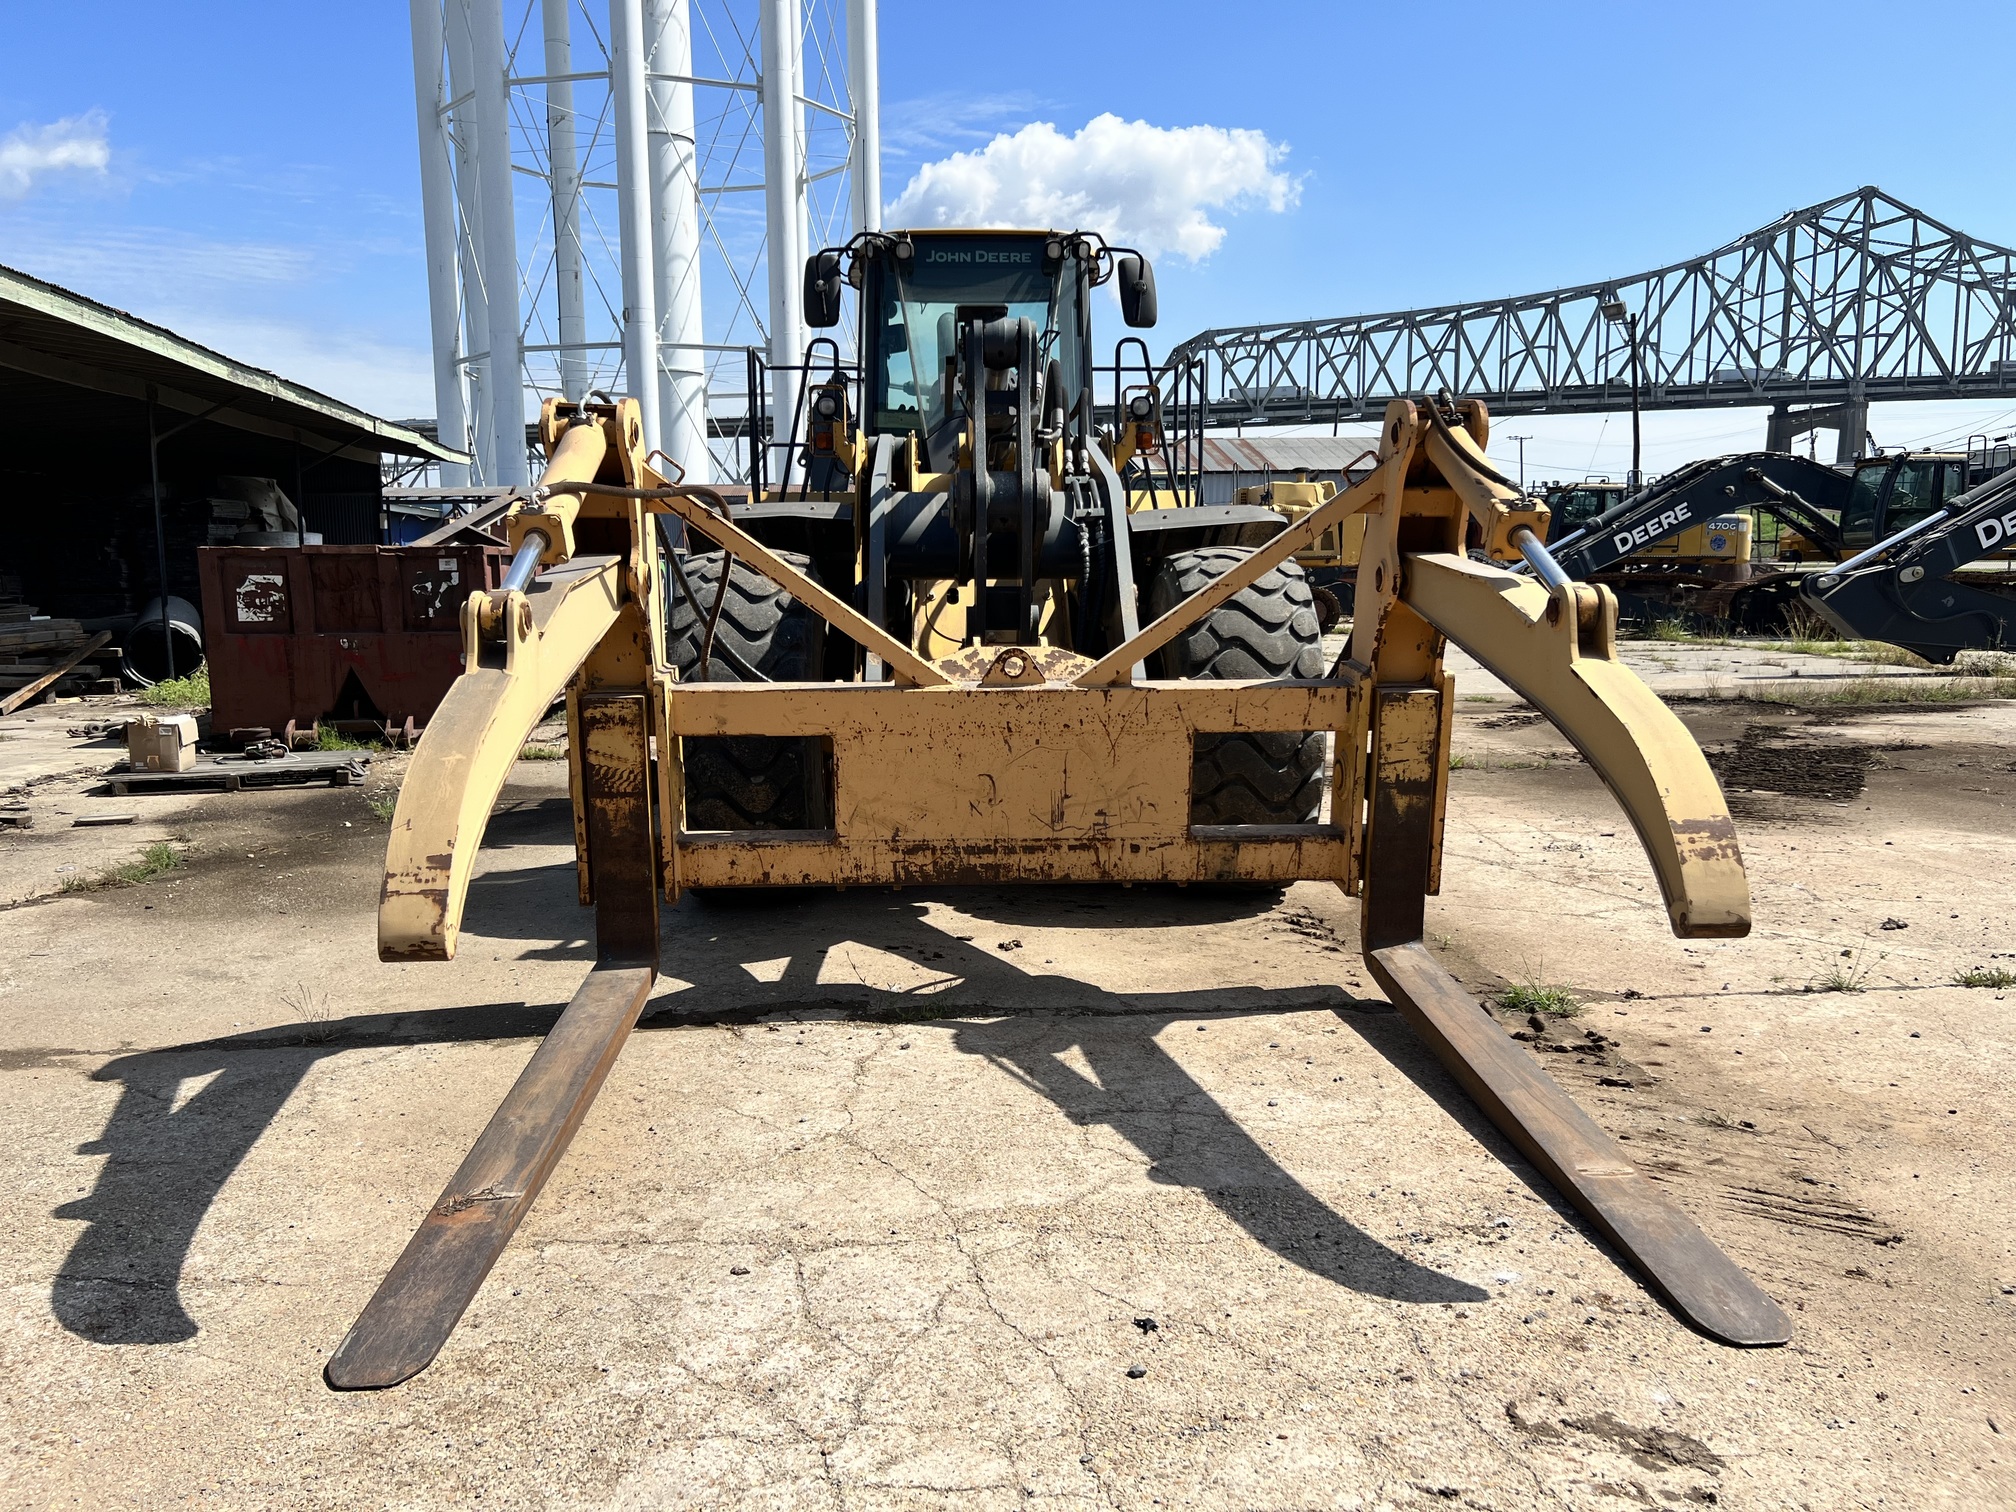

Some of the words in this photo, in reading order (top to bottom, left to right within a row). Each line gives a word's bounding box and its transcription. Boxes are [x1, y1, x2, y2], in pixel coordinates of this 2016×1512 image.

[975, 250, 1032, 263] DEERE
[1613, 501, 1692, 554] DEERE
[1708, 522, 1737, 530] 470G
[1974, 508, 2016, 550] DE
